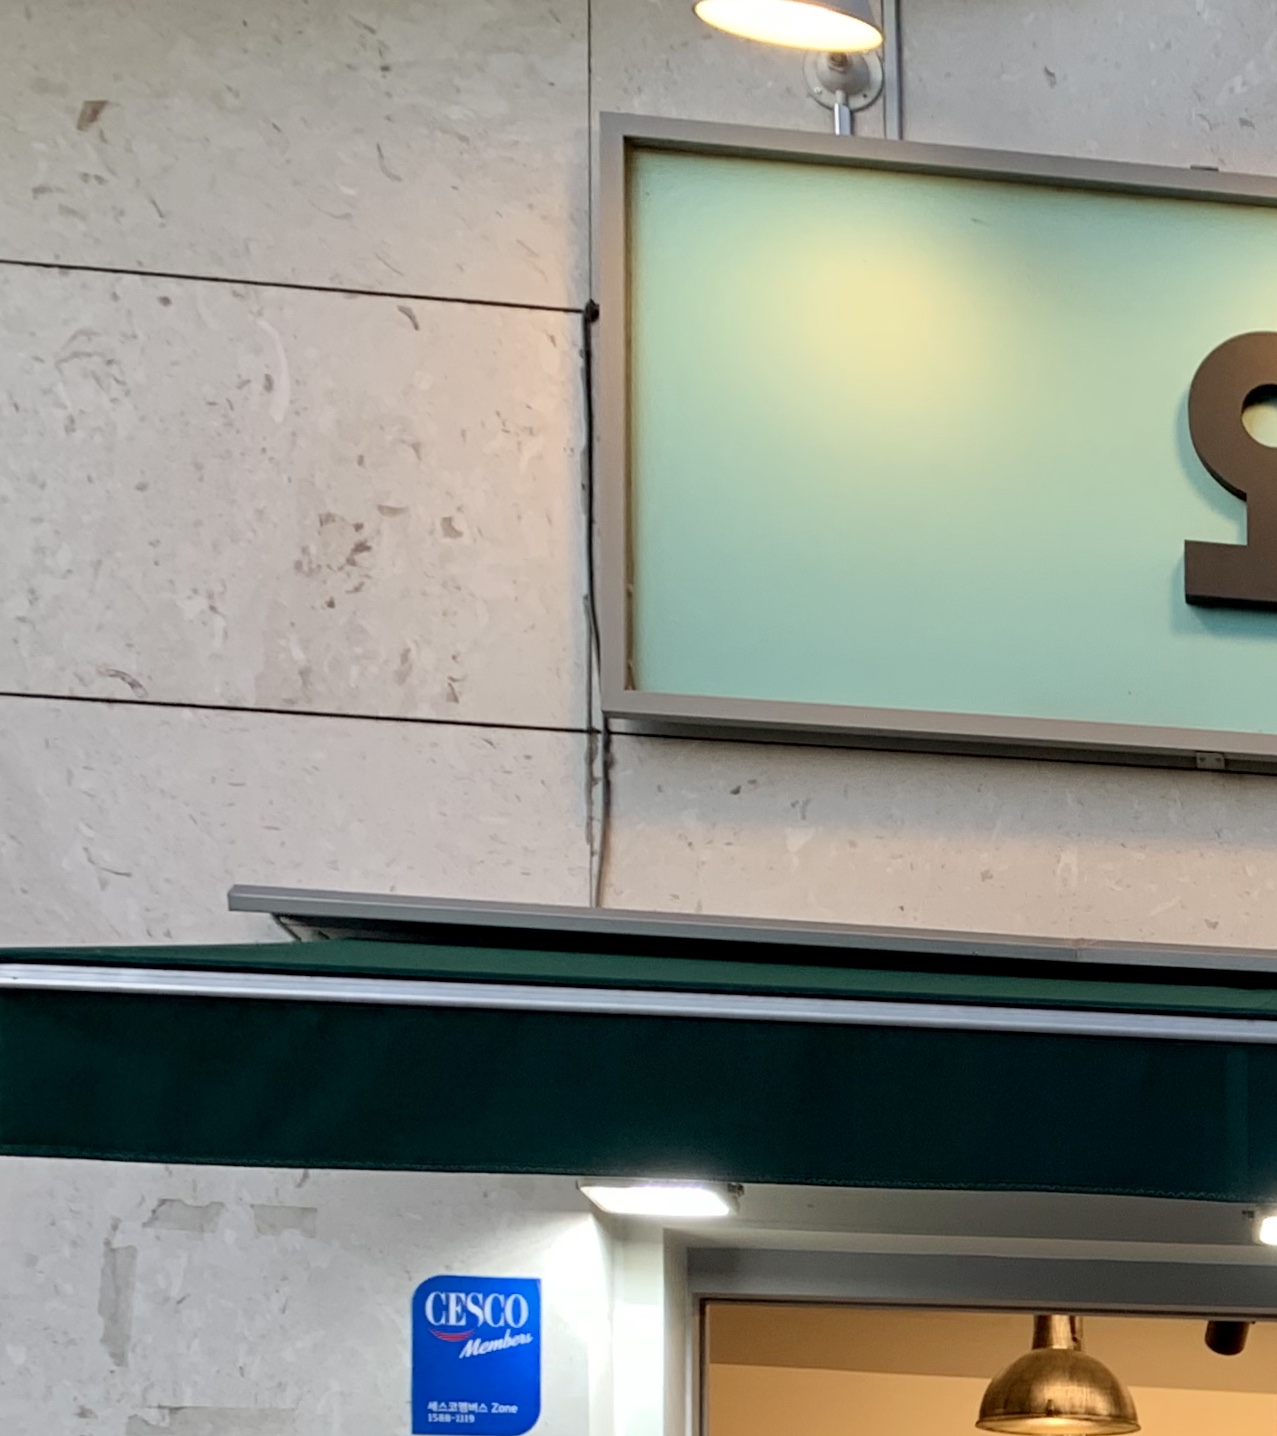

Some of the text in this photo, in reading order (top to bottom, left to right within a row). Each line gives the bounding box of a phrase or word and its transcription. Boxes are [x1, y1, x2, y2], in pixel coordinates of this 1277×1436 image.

[425, 1291, 529, 1329] CESCO
[459, 1329, 534, 1359] Members
[491, 1402, 519, 1413] Zone
